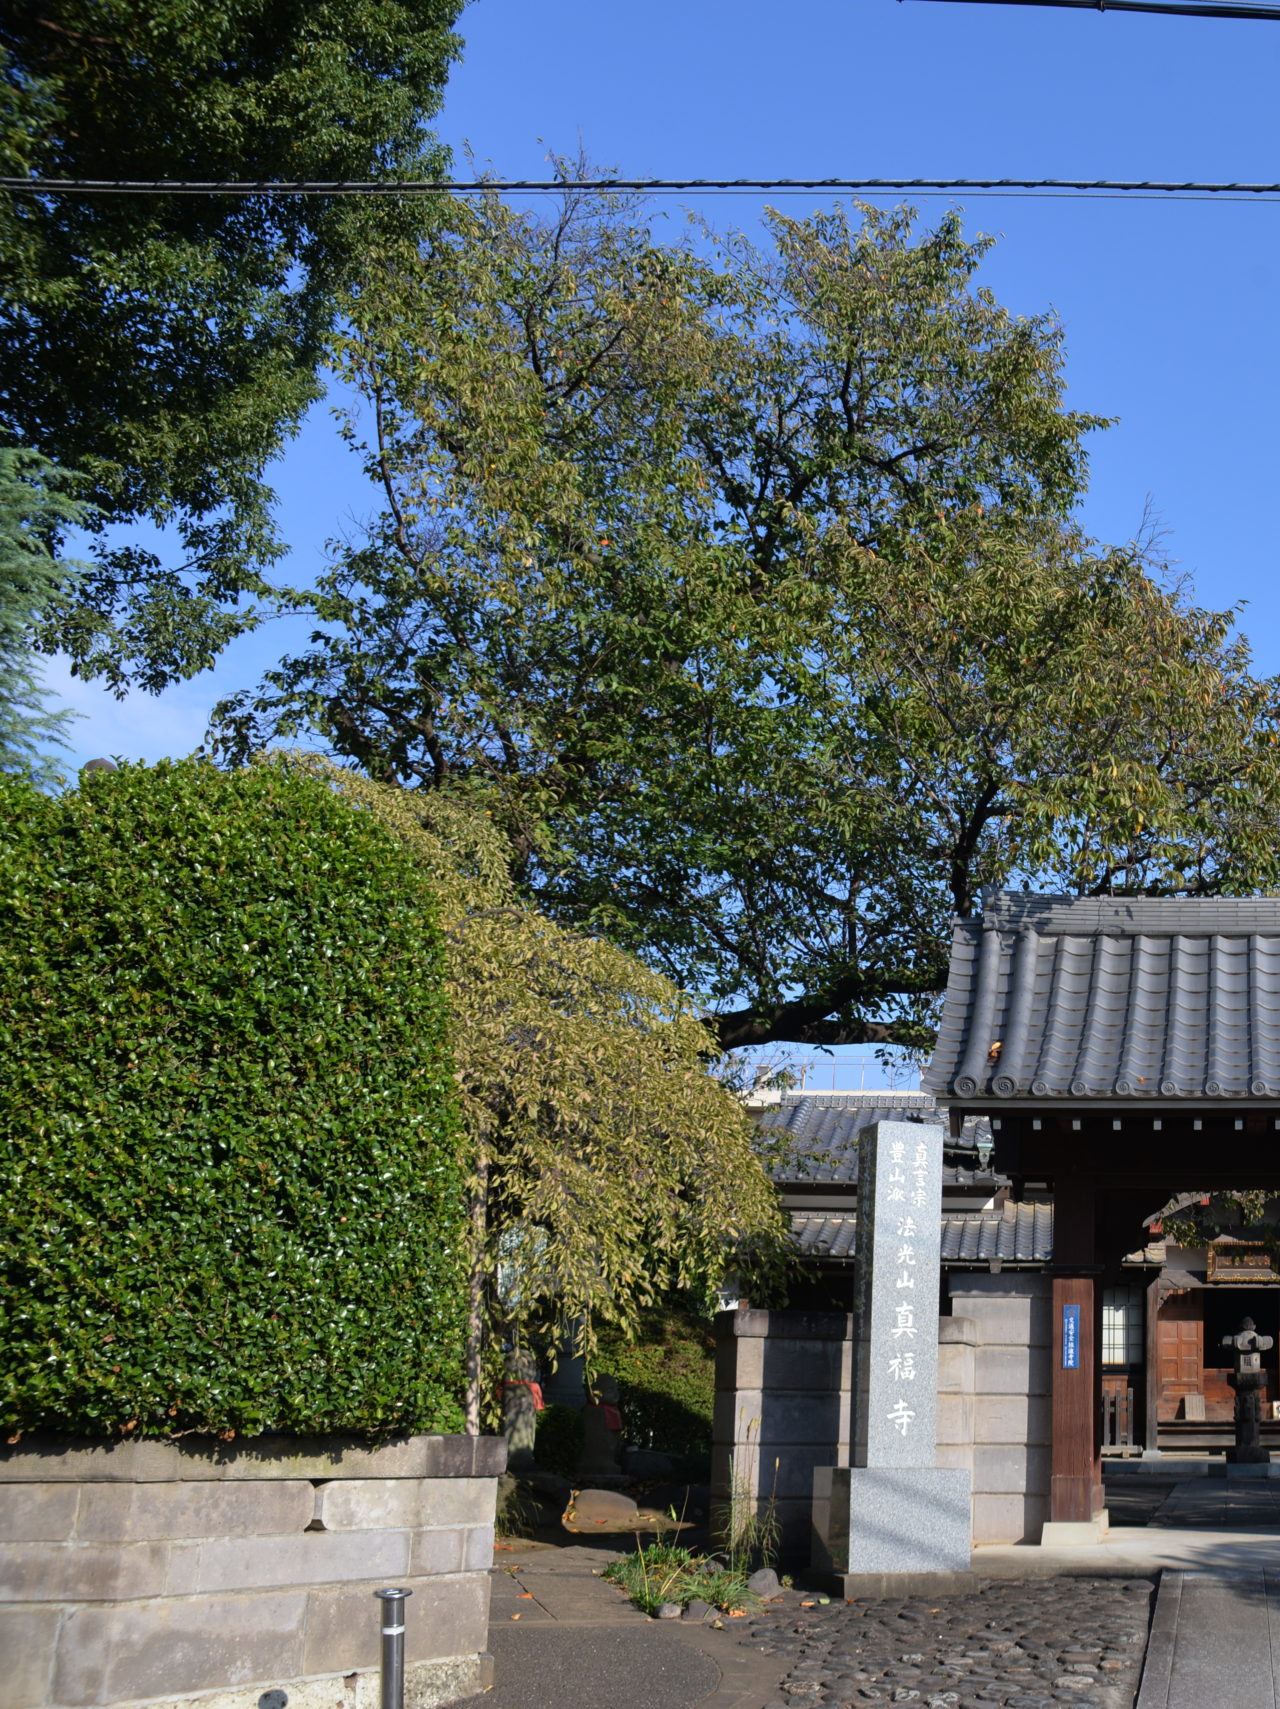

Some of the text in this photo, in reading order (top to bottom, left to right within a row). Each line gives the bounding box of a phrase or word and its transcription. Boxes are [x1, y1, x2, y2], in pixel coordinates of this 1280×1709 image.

[887, 1141, 906, 1202] 豊山派
[911, 1141, 929, 1208] 真言宗
[887, 1216, 918, 1437] 法光山 真福寺
